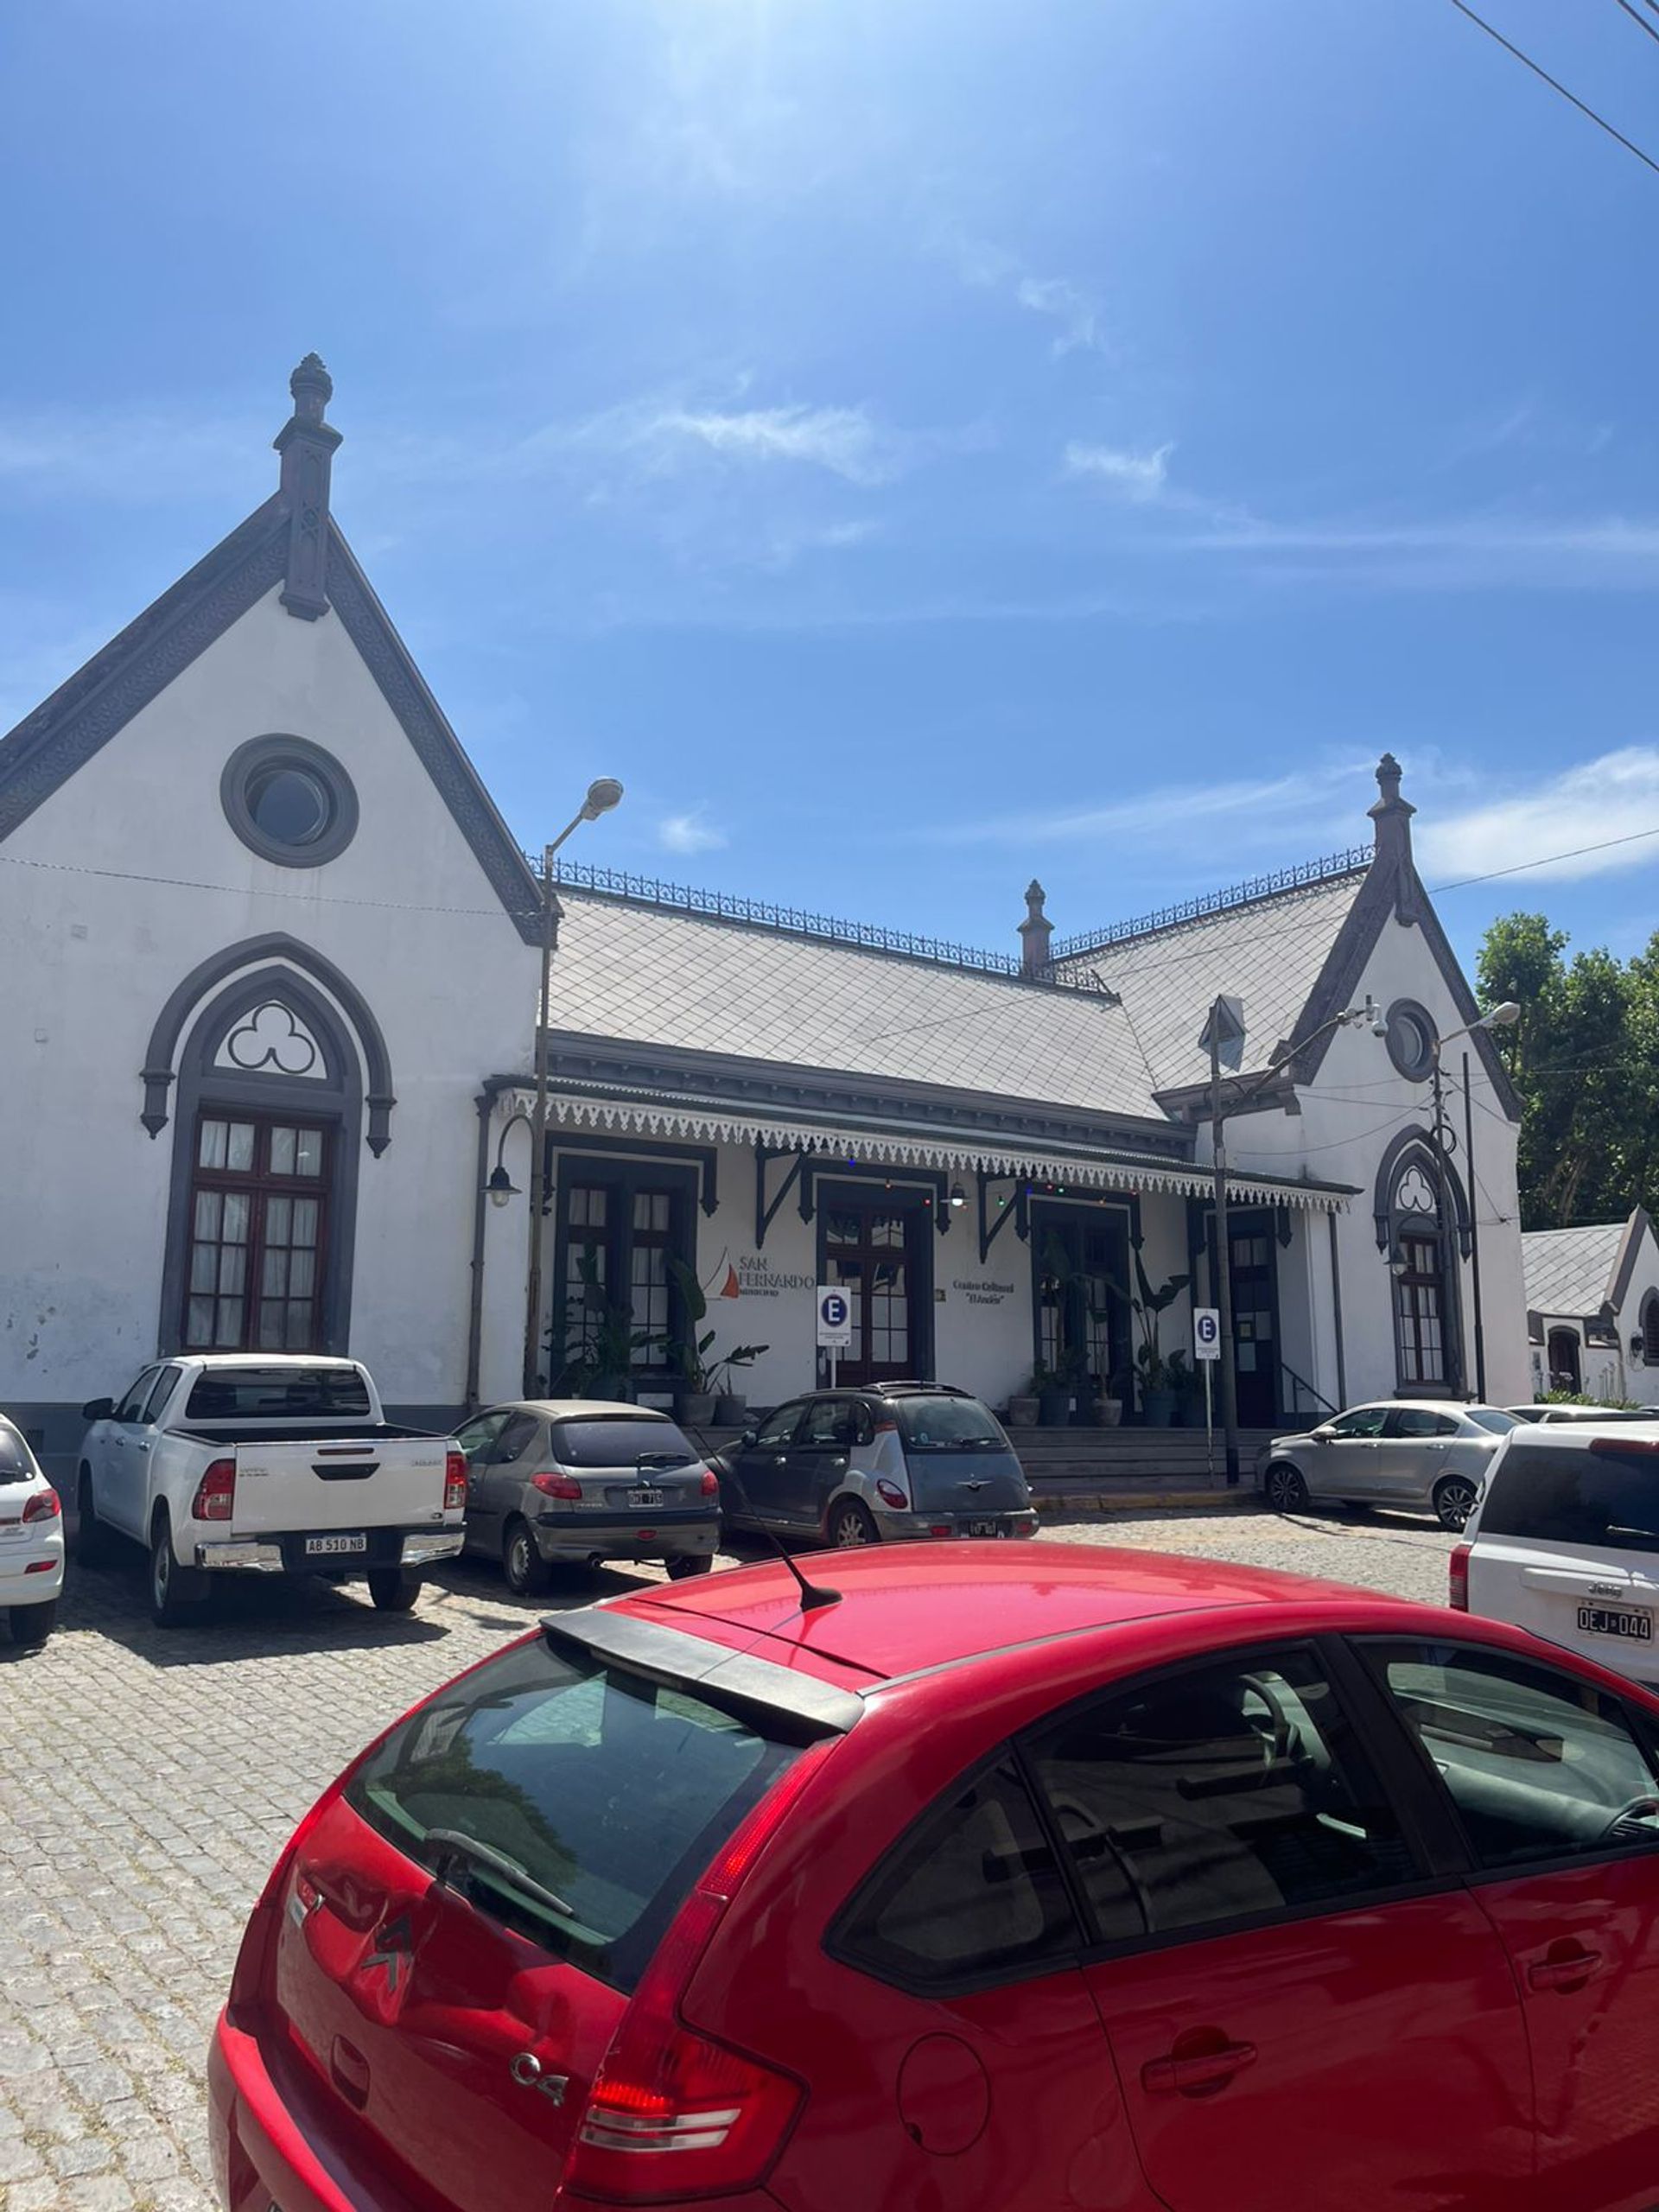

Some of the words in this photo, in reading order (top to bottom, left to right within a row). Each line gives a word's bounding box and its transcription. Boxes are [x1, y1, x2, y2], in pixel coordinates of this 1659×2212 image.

[740, 1256, 768, 1271] SAN
[739, 1272, 815, 1289] FERNANDO
[828, 1299, 841, 1321] E
[1203, 1319, 1212, 1338] E
[308, 1539, 323, 1553] AB
[326, 1538, 347, 1551] 510
[349, 1537, 364, 1550] NB
[1587, 1581, 1623, 1599] Jeep
[1580, 1609, 1609, 1631] OEJ
[1618, 1615, 1649, 1639] 044
[509, 2051, 569, 2107] C4
